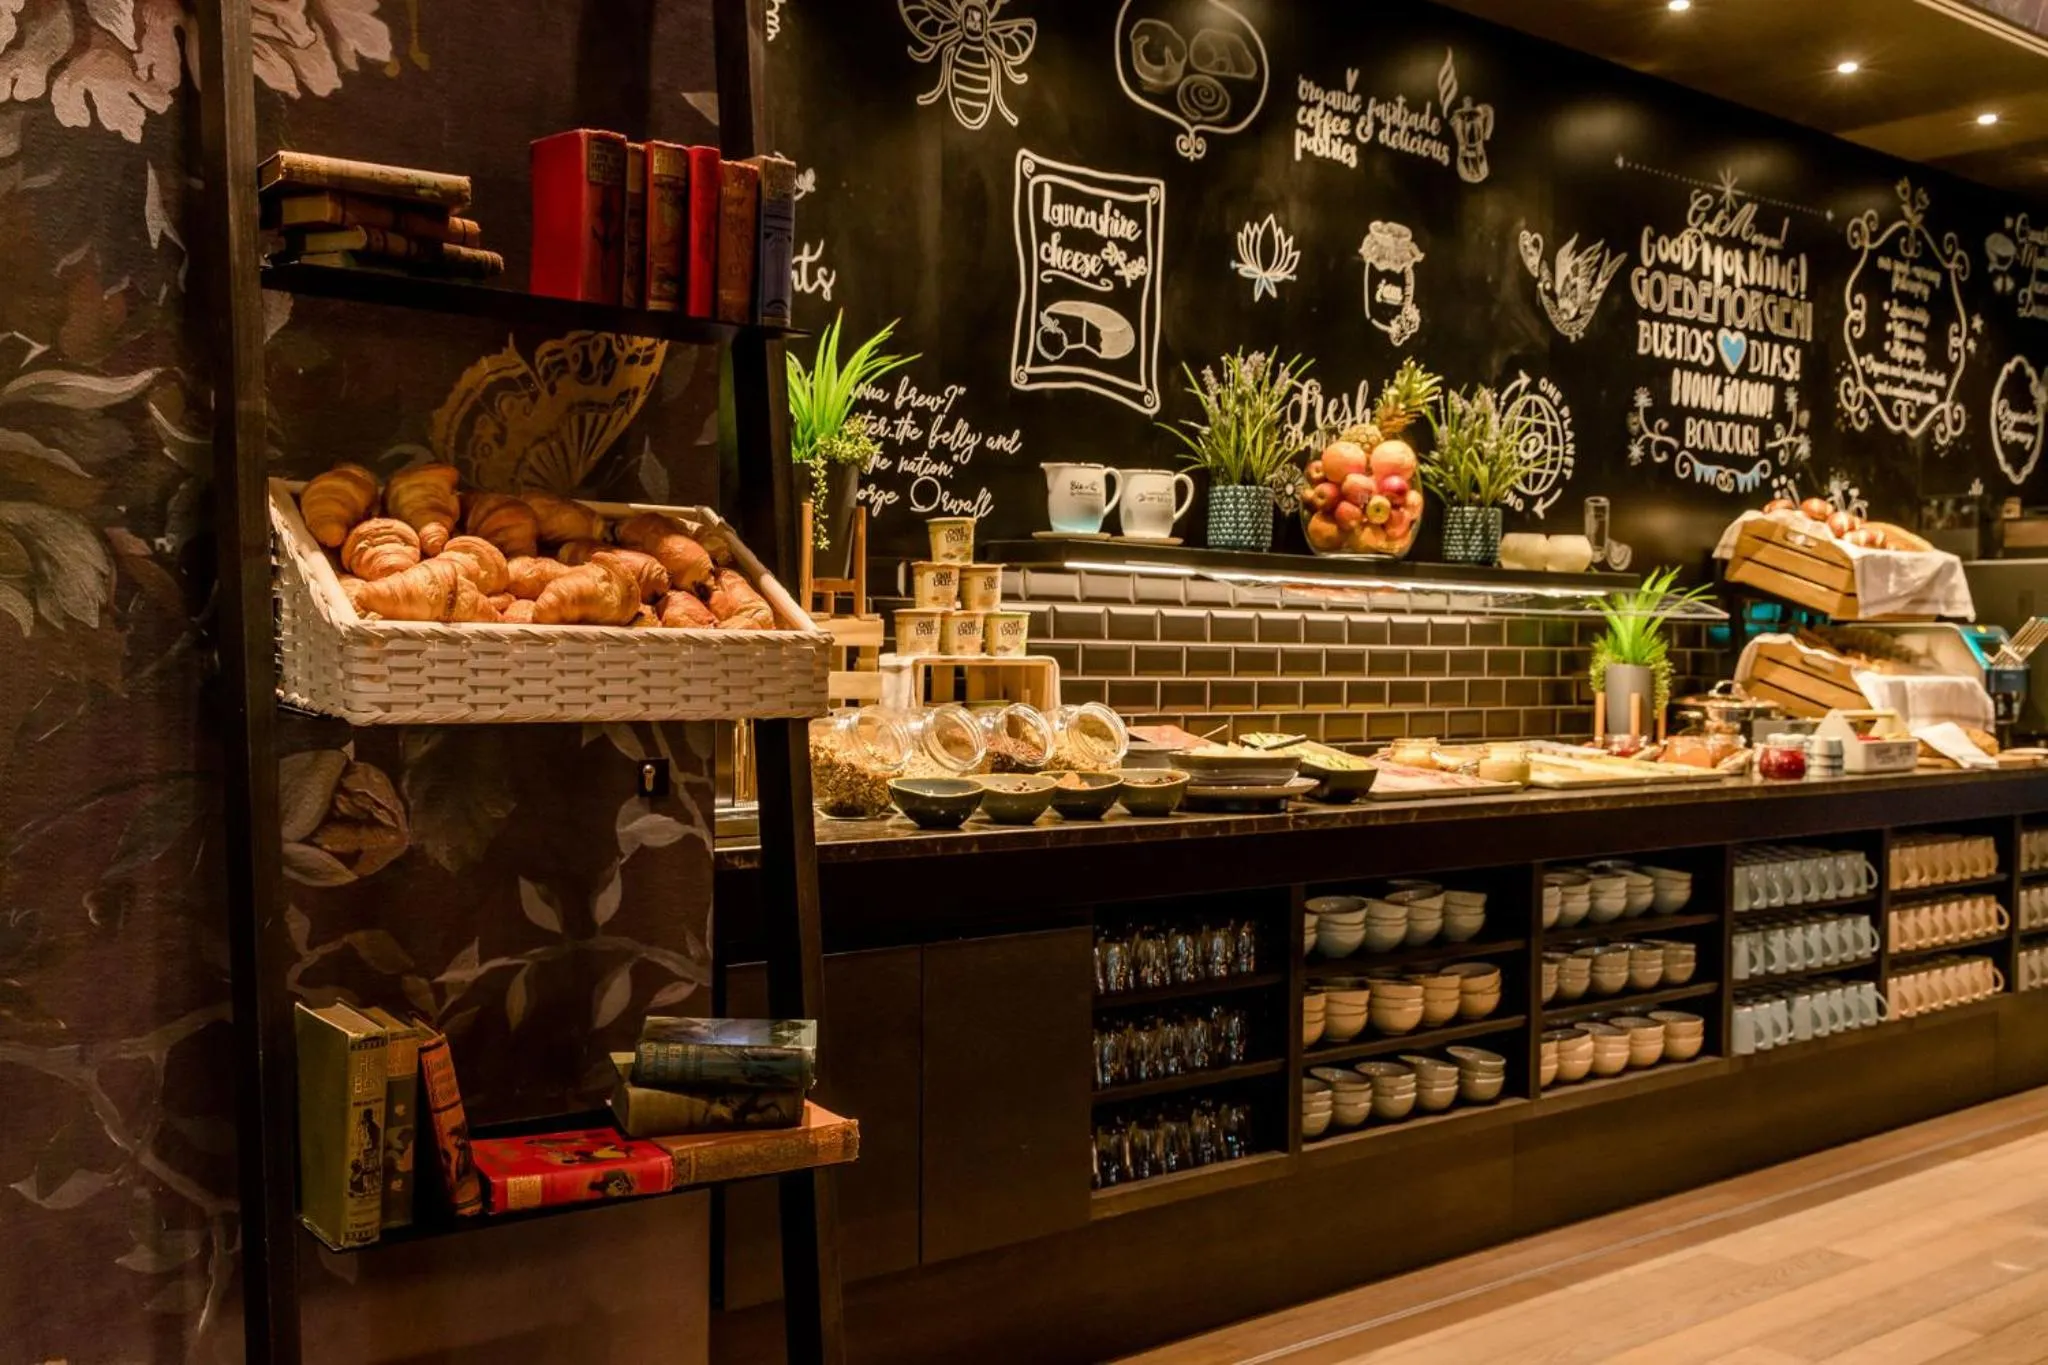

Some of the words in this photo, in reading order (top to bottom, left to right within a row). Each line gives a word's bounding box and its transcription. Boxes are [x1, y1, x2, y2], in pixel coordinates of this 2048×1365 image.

[1298, 73, 1362, 113] organic
[1294, 128, 1357, 169] pastries
[1296, 104, 1351, 142] coffee
[1378, 124, 1450, 166] delicious
[1040, 231, 1104, 278] cheese
[1636, 319, 1716, 367] BUENOS
[1748, 338, 1802, 382] DIAS!
[928, 413, 982, 465] belly
[985, 429, 1023, 455] and
[1538, 376, 1563, 407] ONE
[1558, 405, 1577, 481] PLANET
[1684, 415, 1761, 457] BONJOUR!
